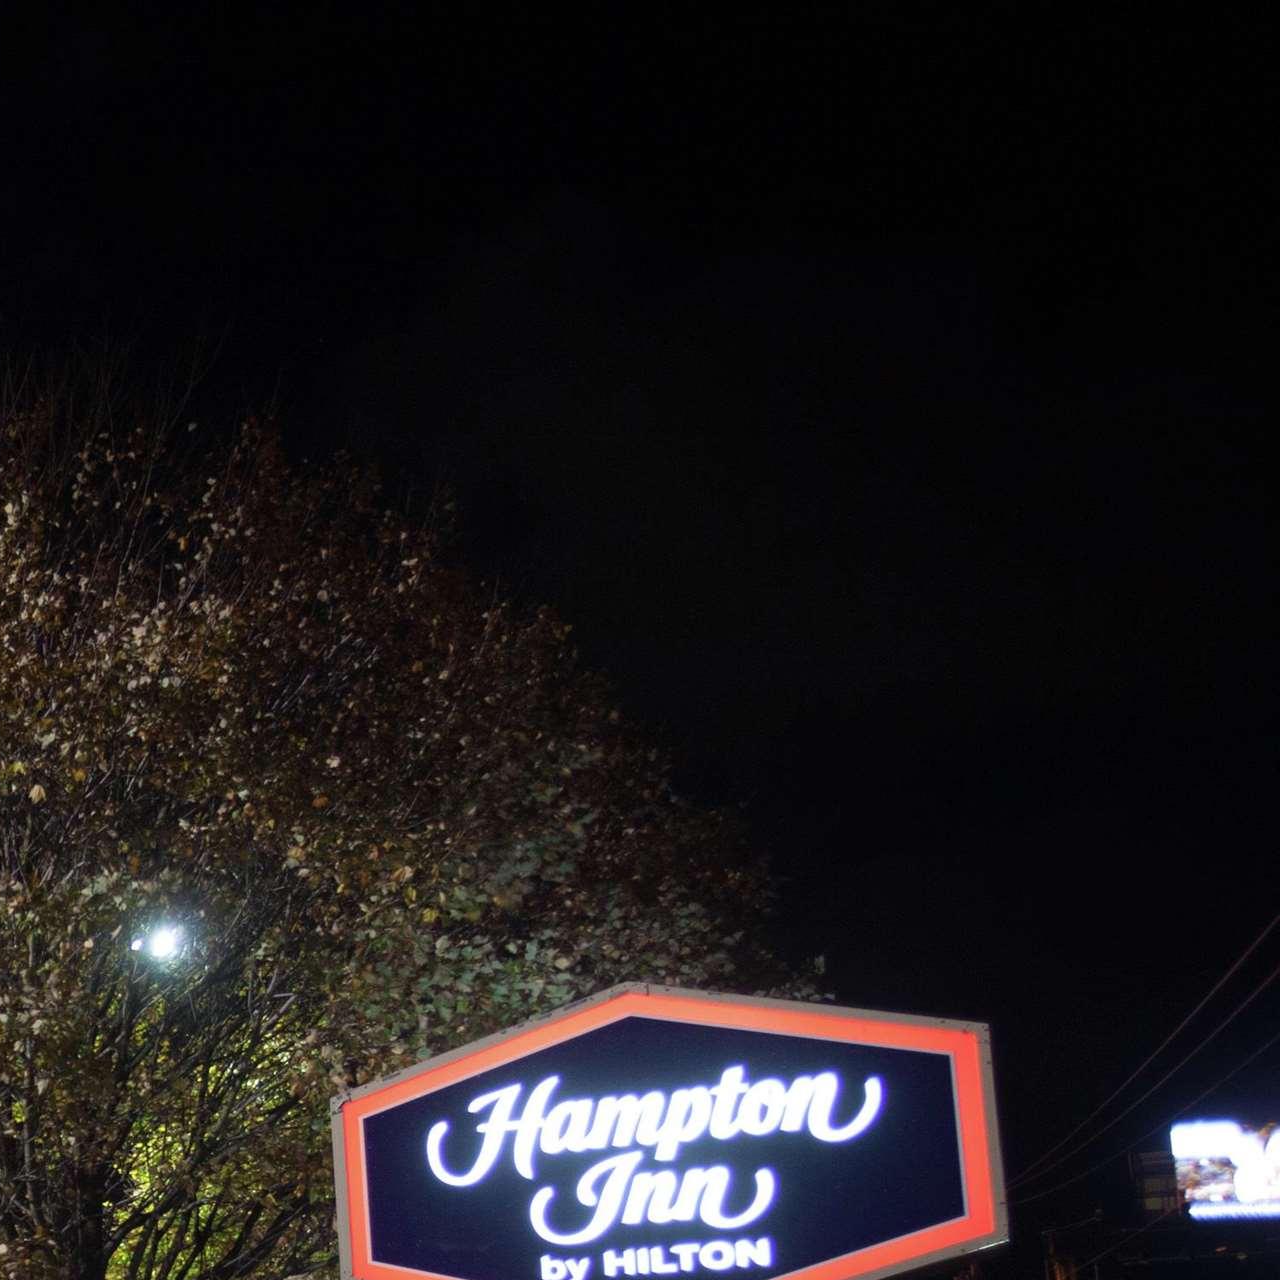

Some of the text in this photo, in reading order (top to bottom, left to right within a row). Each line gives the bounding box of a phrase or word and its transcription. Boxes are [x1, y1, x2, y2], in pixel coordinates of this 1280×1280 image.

[426, 1065, 883, 1187] Hampton
[529, 1151, 776, 1246] Inn
[602, 1237, 772, 1278] HILTON
